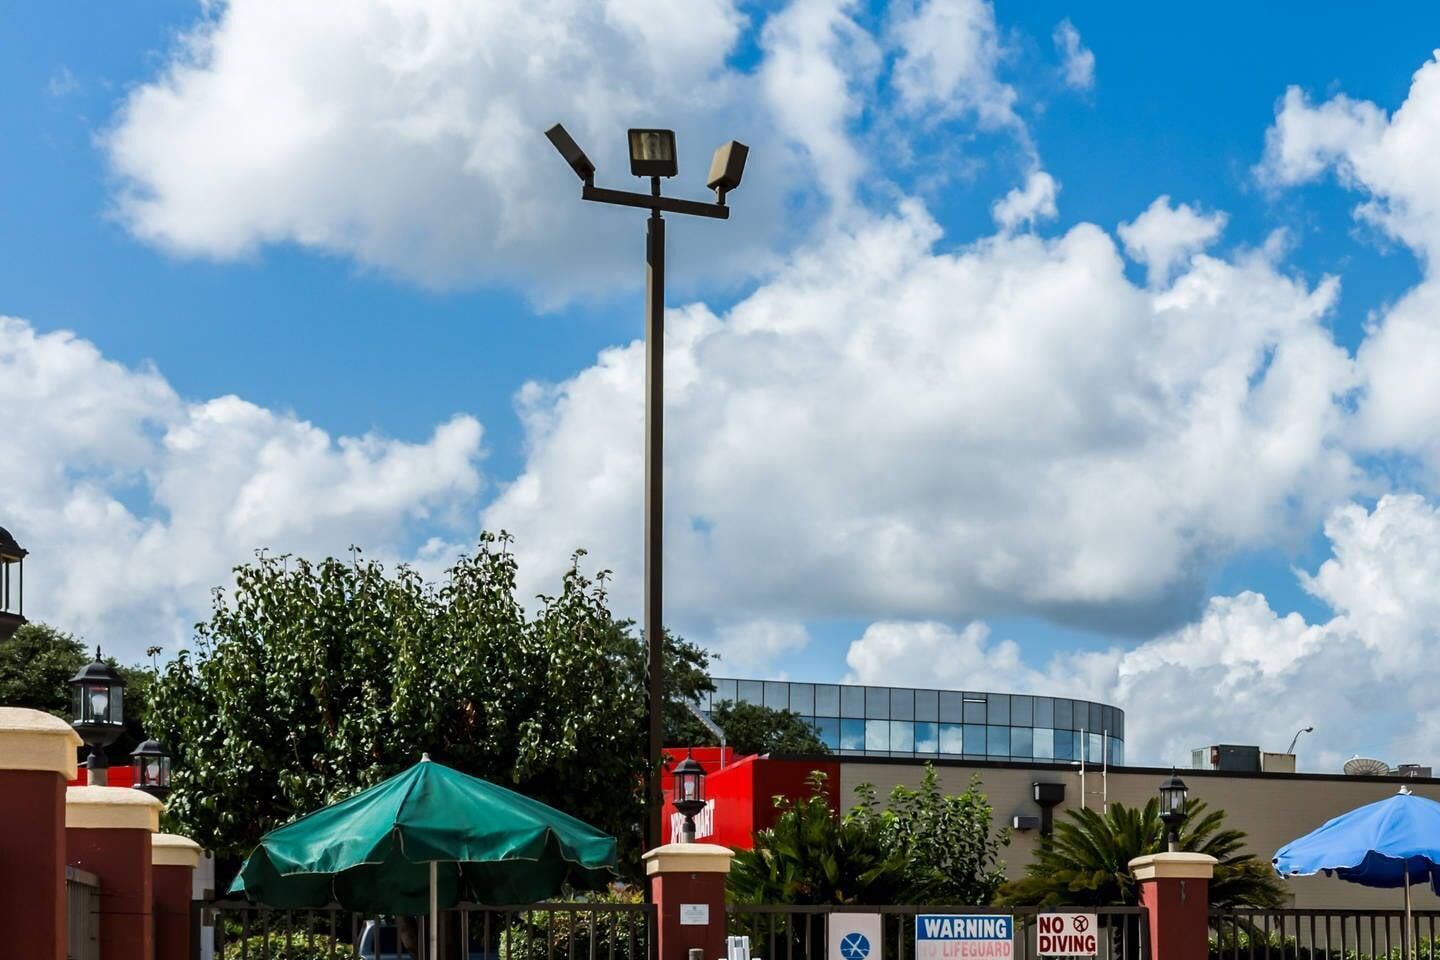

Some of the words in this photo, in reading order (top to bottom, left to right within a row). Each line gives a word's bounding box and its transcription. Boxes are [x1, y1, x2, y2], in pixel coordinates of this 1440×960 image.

[924, 918, 1007, 938] WARNING
[1039, 916, 1064, 934] NO
[943, 941, 1011, 958] LIFEGUARD
[1039, 935, 1096, 953] DIVING
